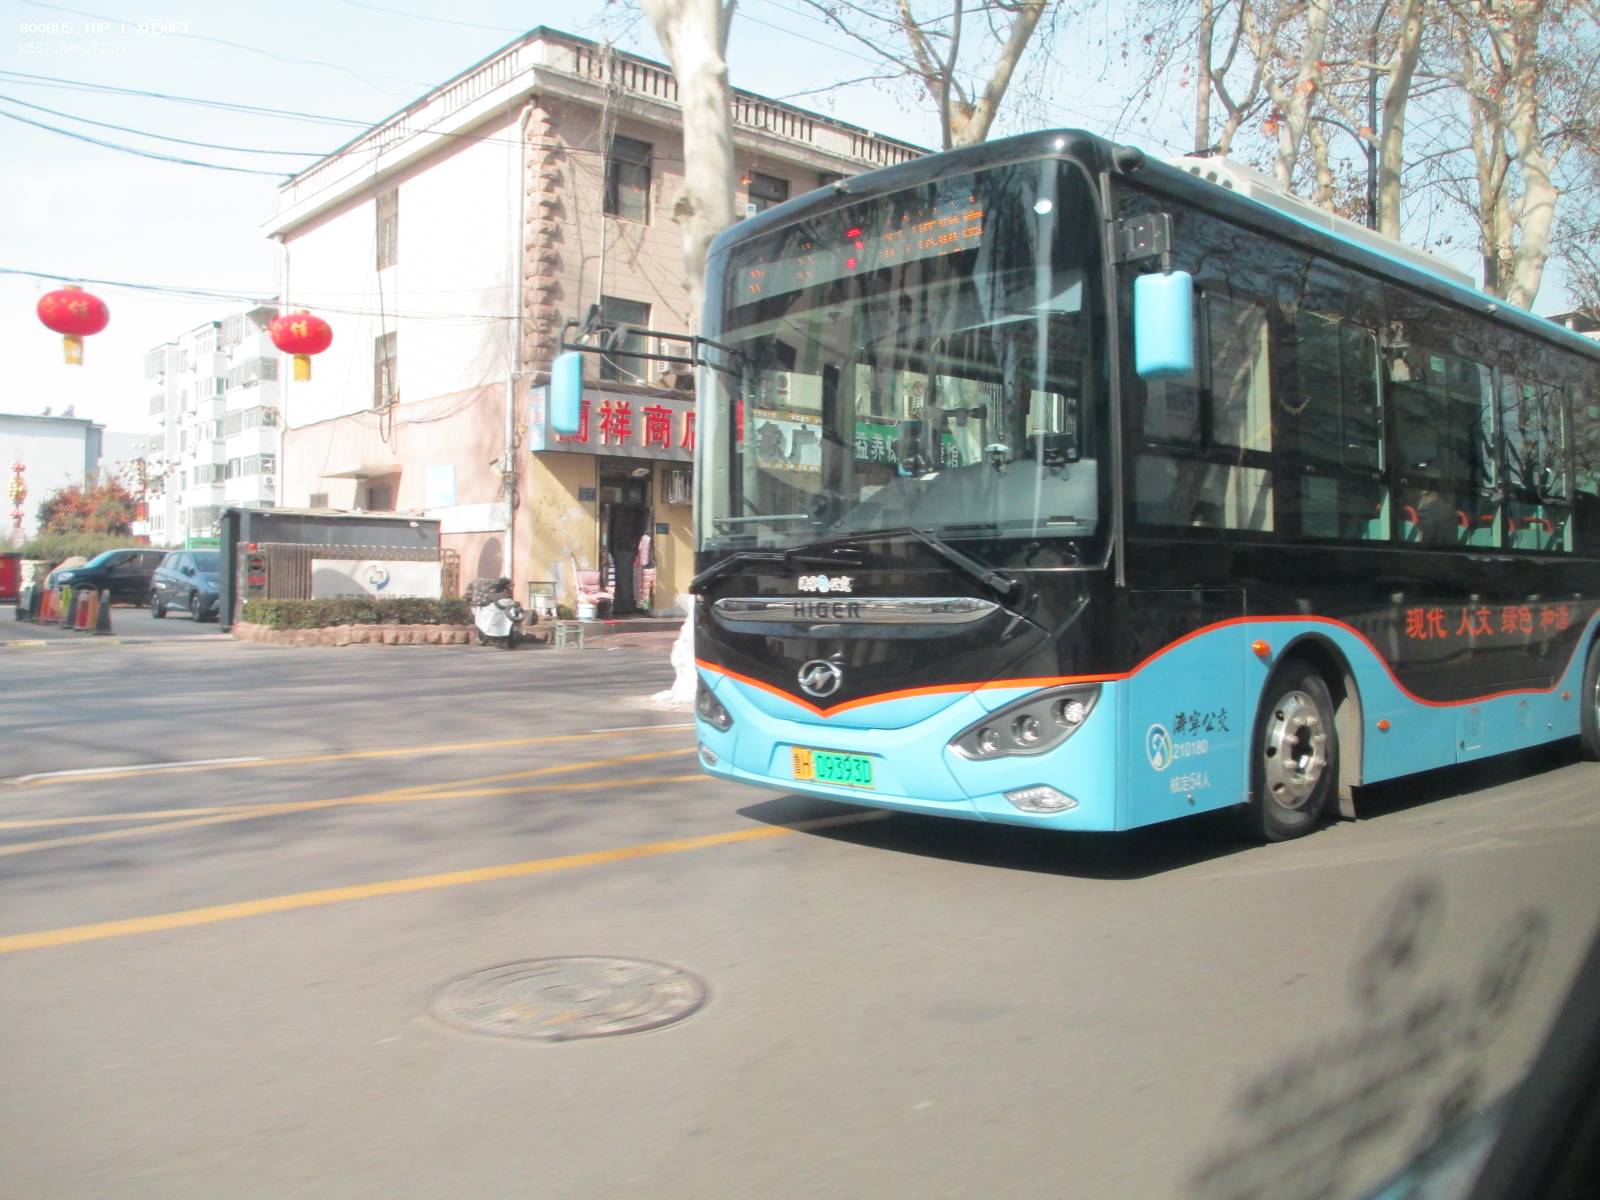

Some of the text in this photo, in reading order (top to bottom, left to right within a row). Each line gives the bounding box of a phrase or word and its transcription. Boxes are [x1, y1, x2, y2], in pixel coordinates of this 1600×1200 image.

[793, 602, 861, 618] HIGER
[1406, 607, 1447, 640] 现代
[1456, 605, 1493, 637] 人文
